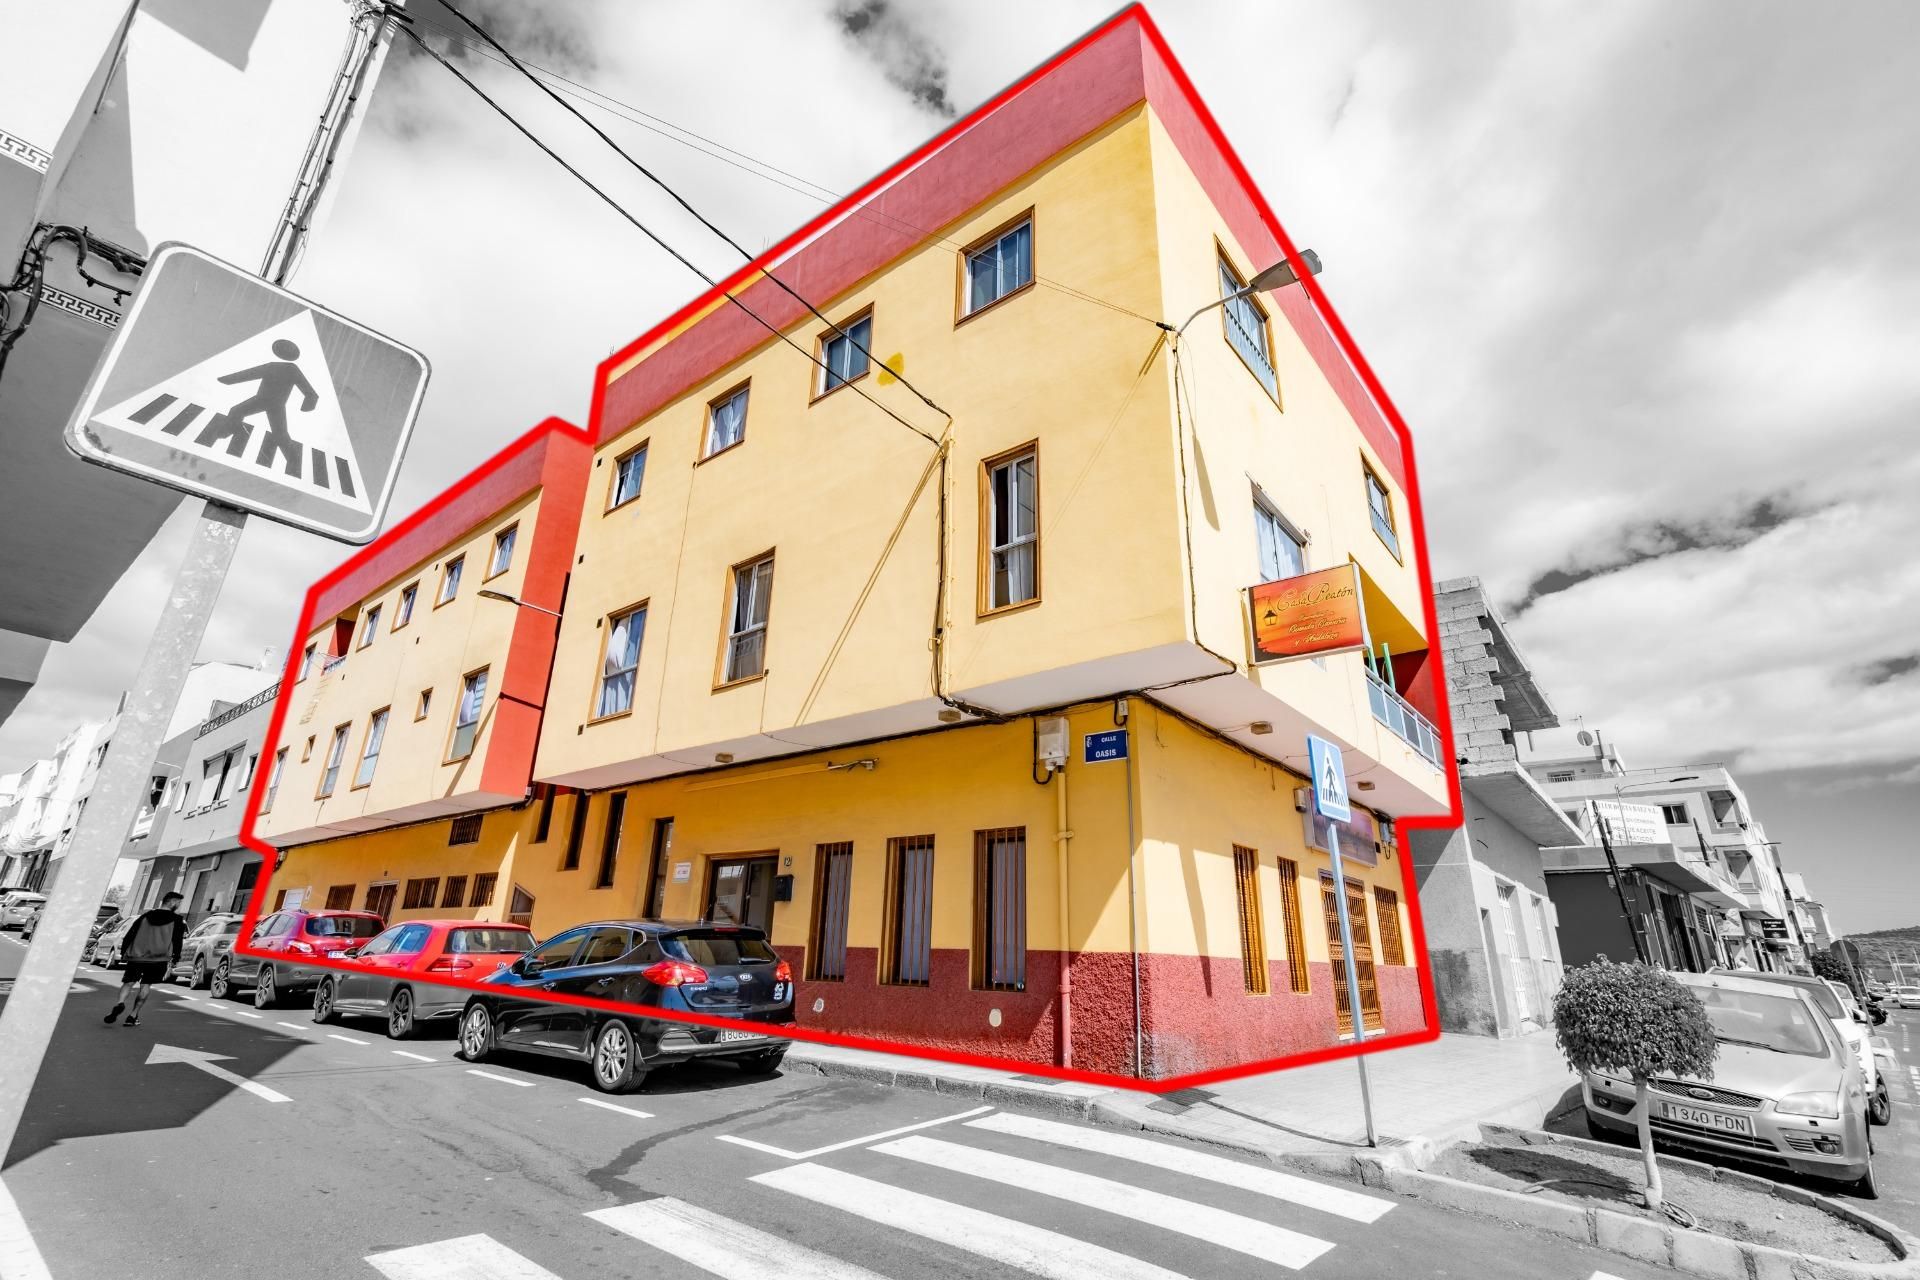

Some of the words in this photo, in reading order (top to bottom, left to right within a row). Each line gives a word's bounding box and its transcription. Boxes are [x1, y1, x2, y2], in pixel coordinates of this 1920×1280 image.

[1277, 588, 1307, 611] Casa
[1095, 749, 1117, 758] OASIS
[1672, 1106, 1709, 1124] 1340
[1714, 1114, 1745, 1132] FDN
